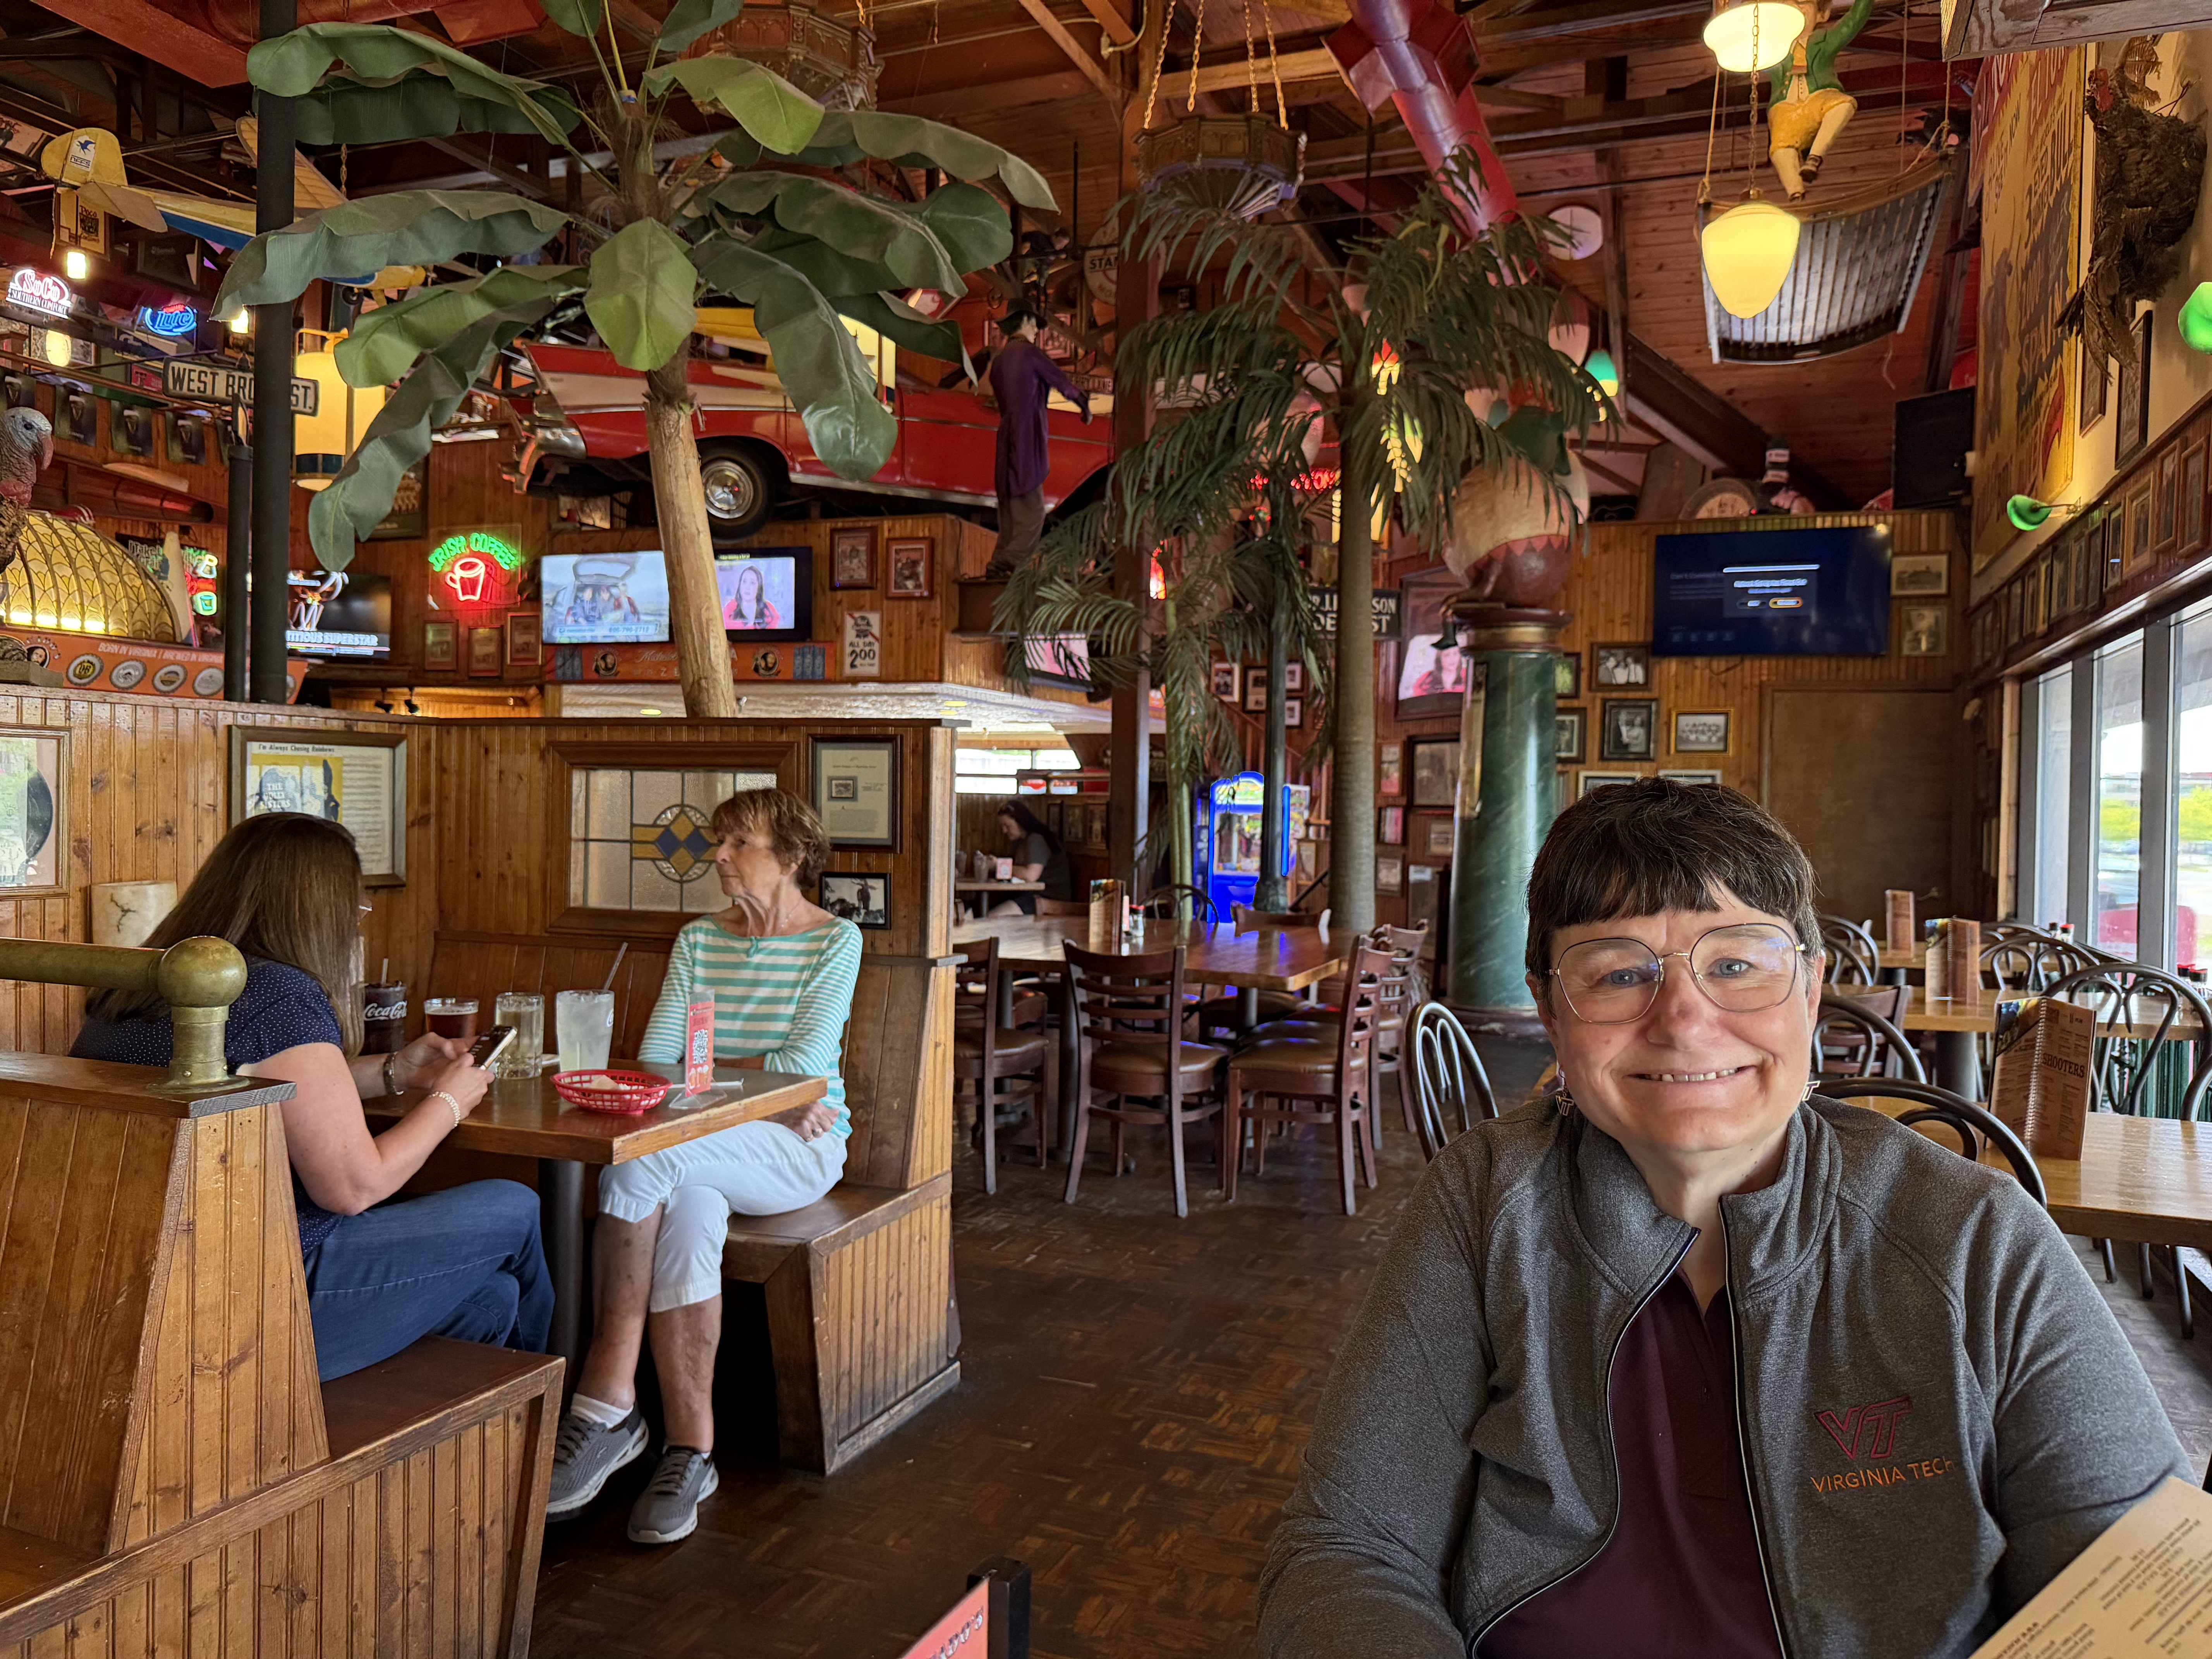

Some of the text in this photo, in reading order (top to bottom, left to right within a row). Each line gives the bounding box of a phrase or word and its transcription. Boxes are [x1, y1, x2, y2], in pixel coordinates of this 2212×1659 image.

[2021, 267, 2063, 396] SPAIN
[171, 366, 219, 395] WEST
[429, 532, 515, 572] IRISH COFFEE
[323, 632, 378, 646] SUPERSTAR
[269, 744, 288, 754] Always
[2042, 1053, 2085, 1078] SHOOTERS
[1815, 1394, 1914, 1460] VT
[1810, 1466, 1906, 1492] VIRGINIA
